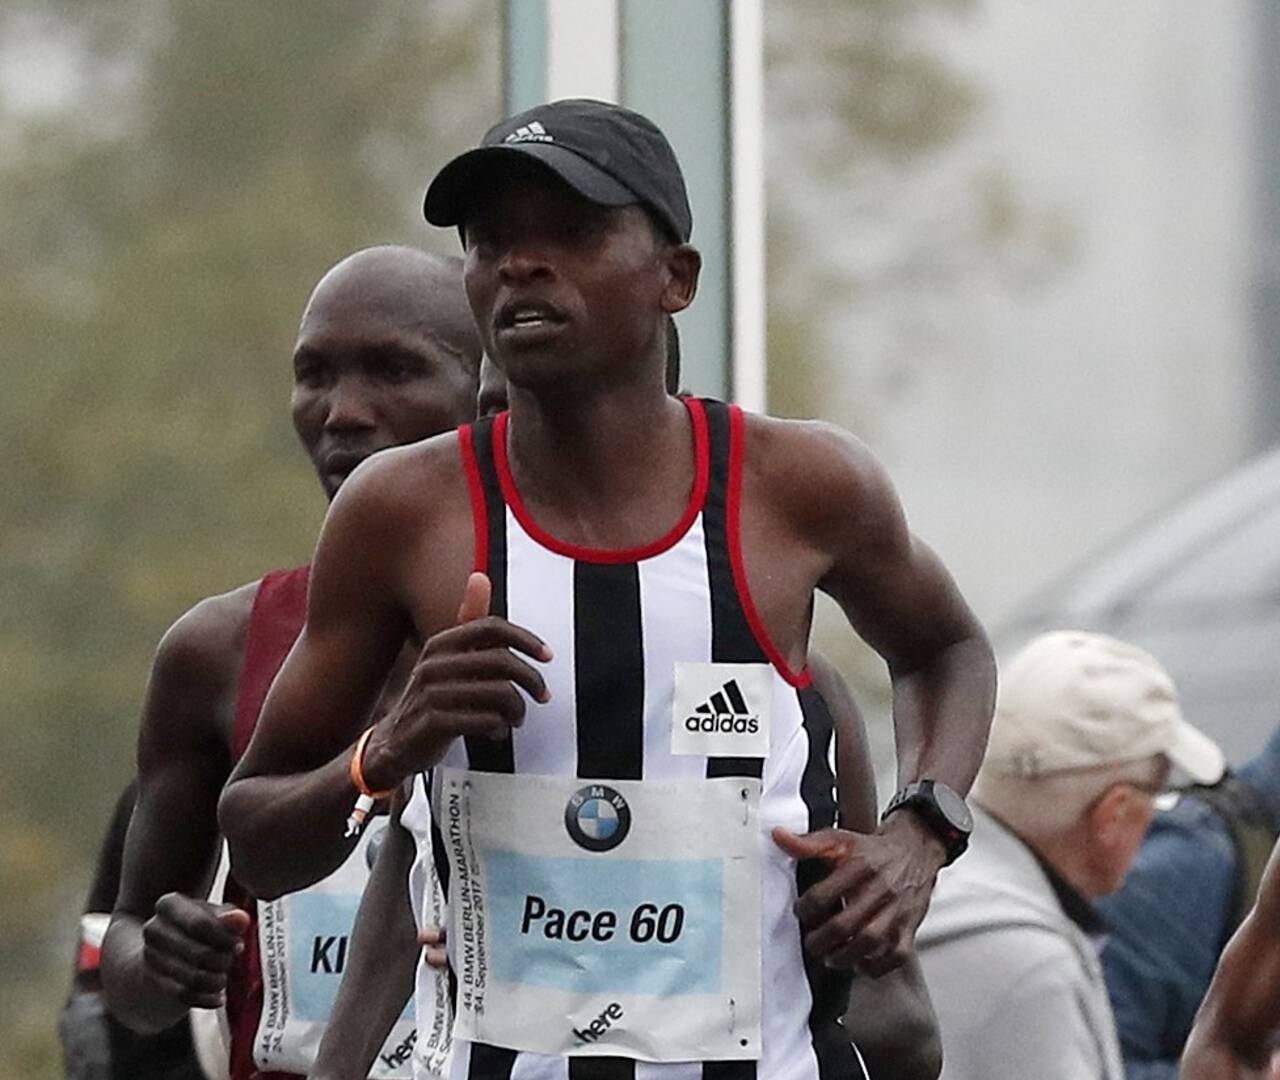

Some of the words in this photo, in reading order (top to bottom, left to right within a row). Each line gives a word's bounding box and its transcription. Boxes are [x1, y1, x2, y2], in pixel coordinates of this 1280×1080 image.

[685, 714, 759, 733] adidas
[521, 896, 616, 941] Pace
[630, 903, 685, 943] 60
[573, 1002, 623, 1045] here
